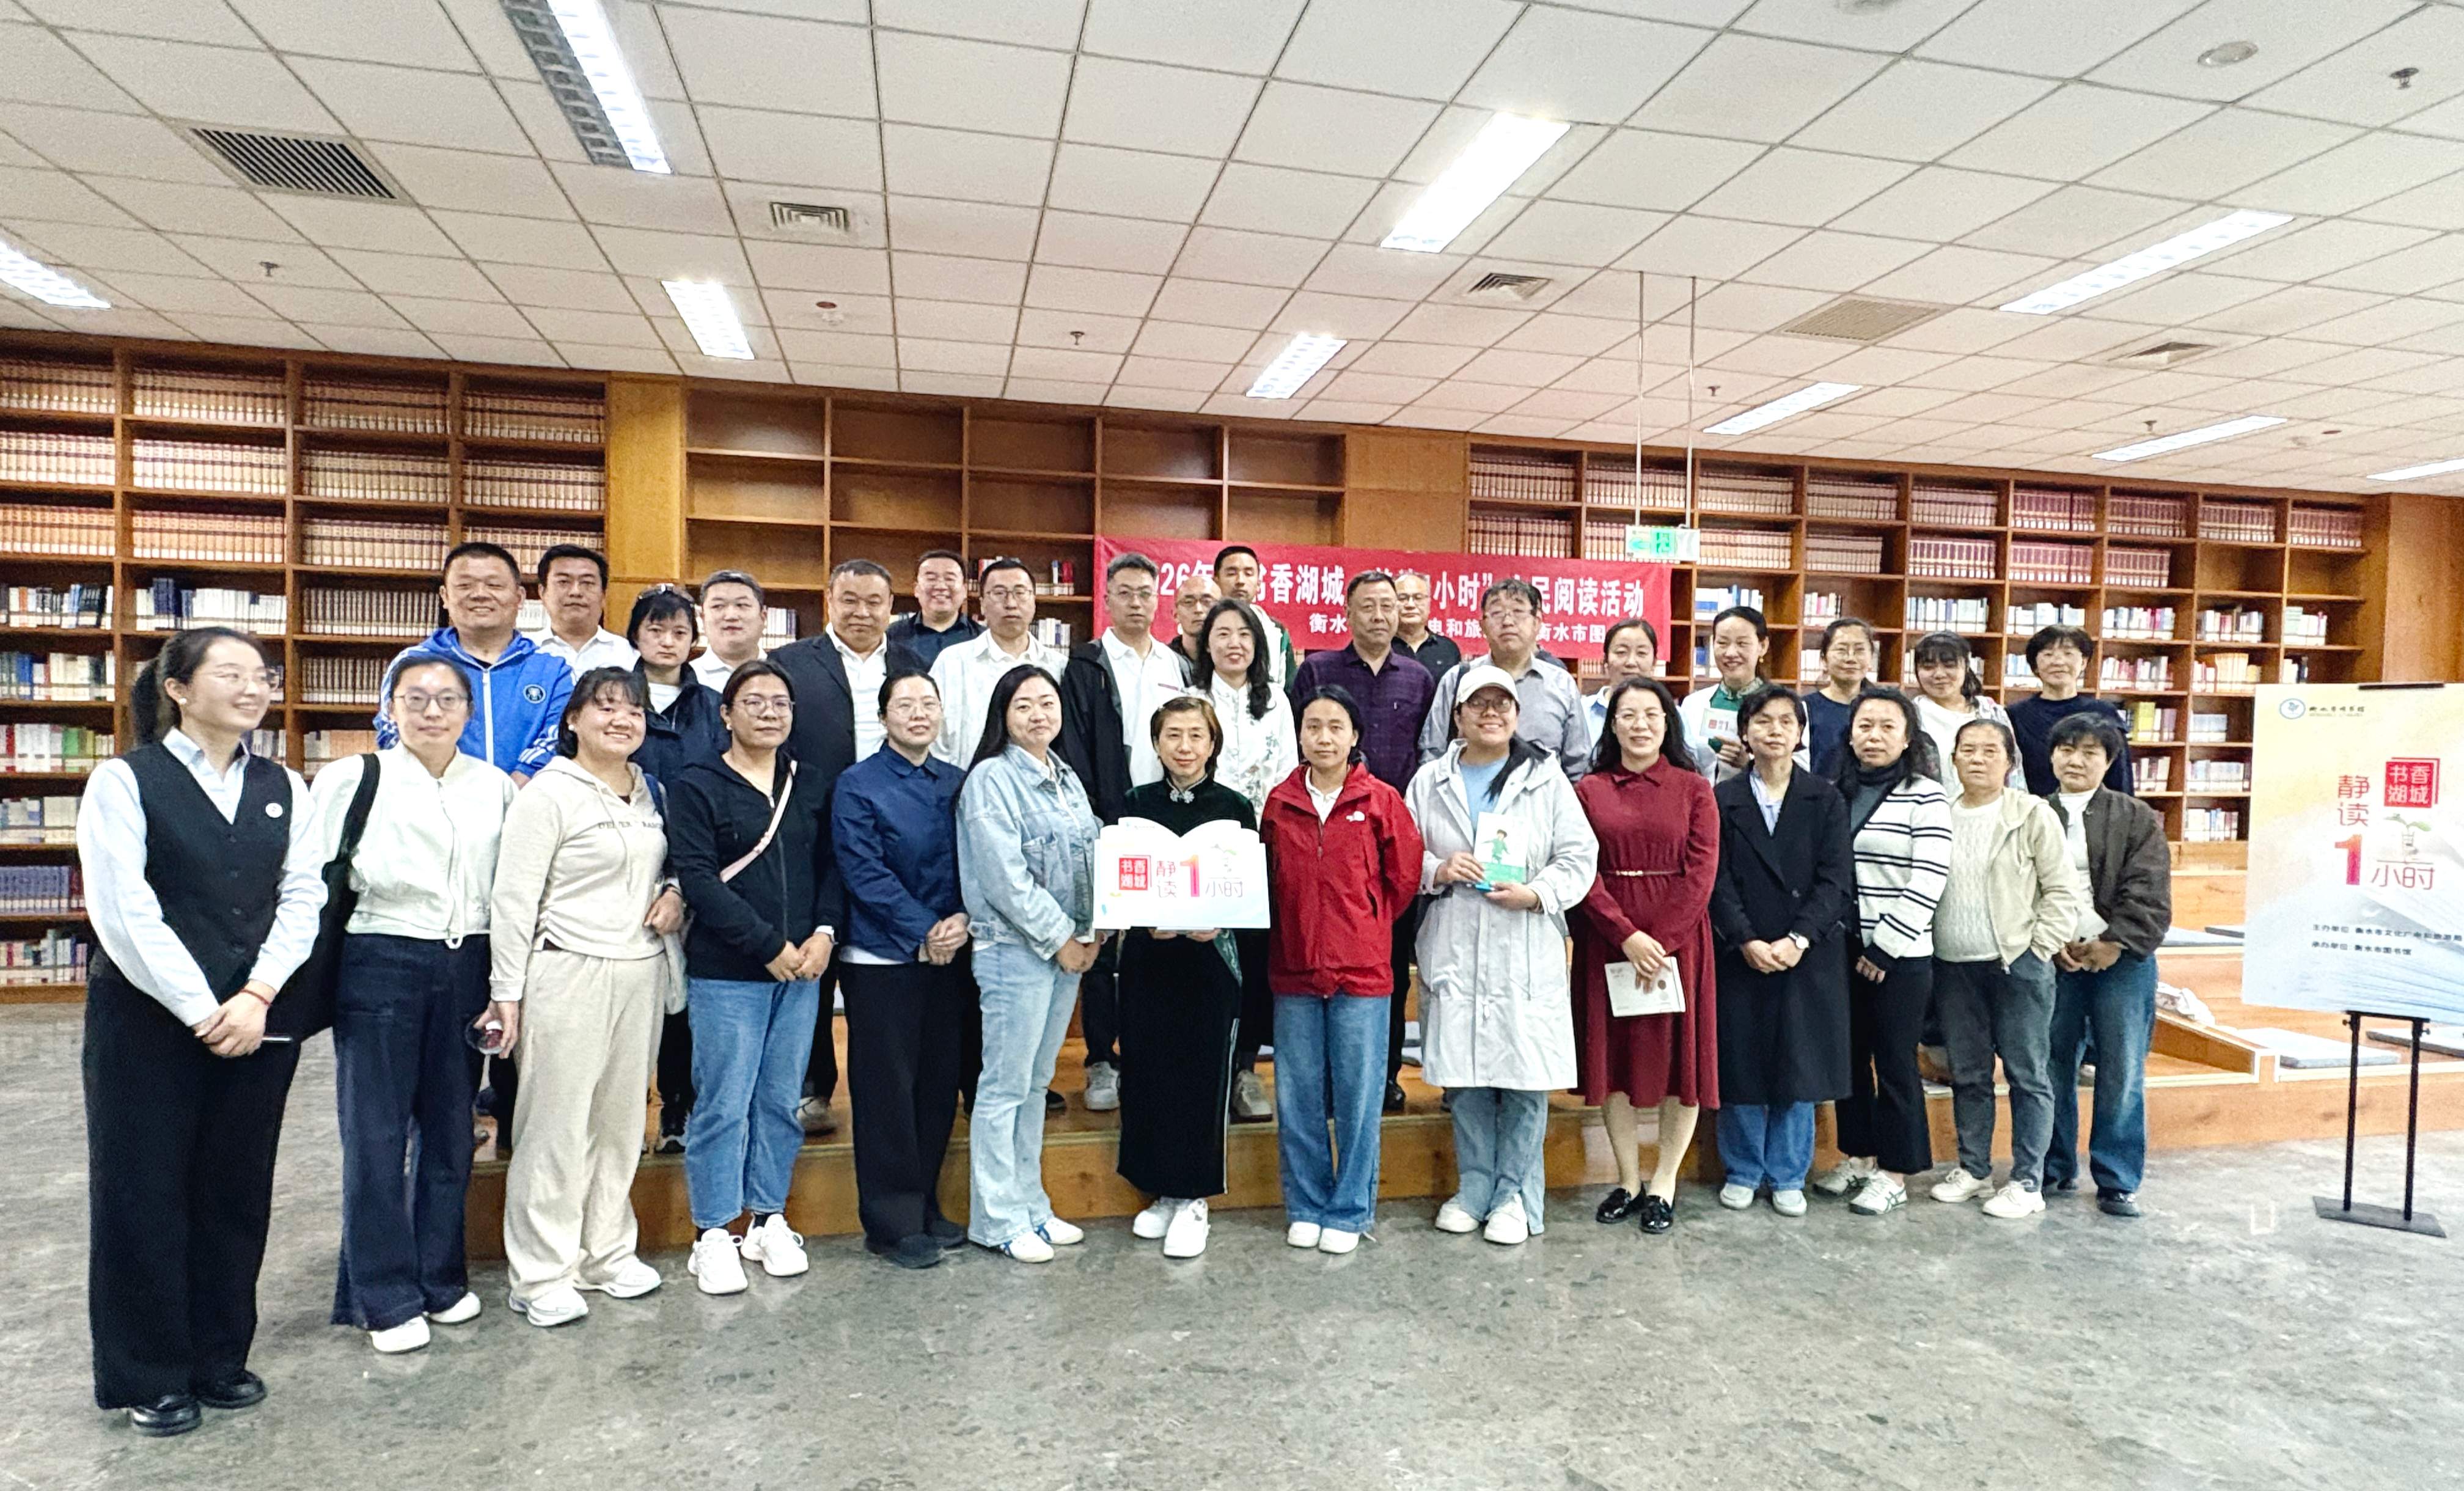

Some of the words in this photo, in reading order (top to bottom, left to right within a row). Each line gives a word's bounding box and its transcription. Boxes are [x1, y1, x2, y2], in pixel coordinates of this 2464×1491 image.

[2388, 764, 2430, 785] 书香
[2337, 774, 2370, 827] 静读
[2387, 785, 2430, 805] 湖城
[1156, 860, 1177, 898] 静读
